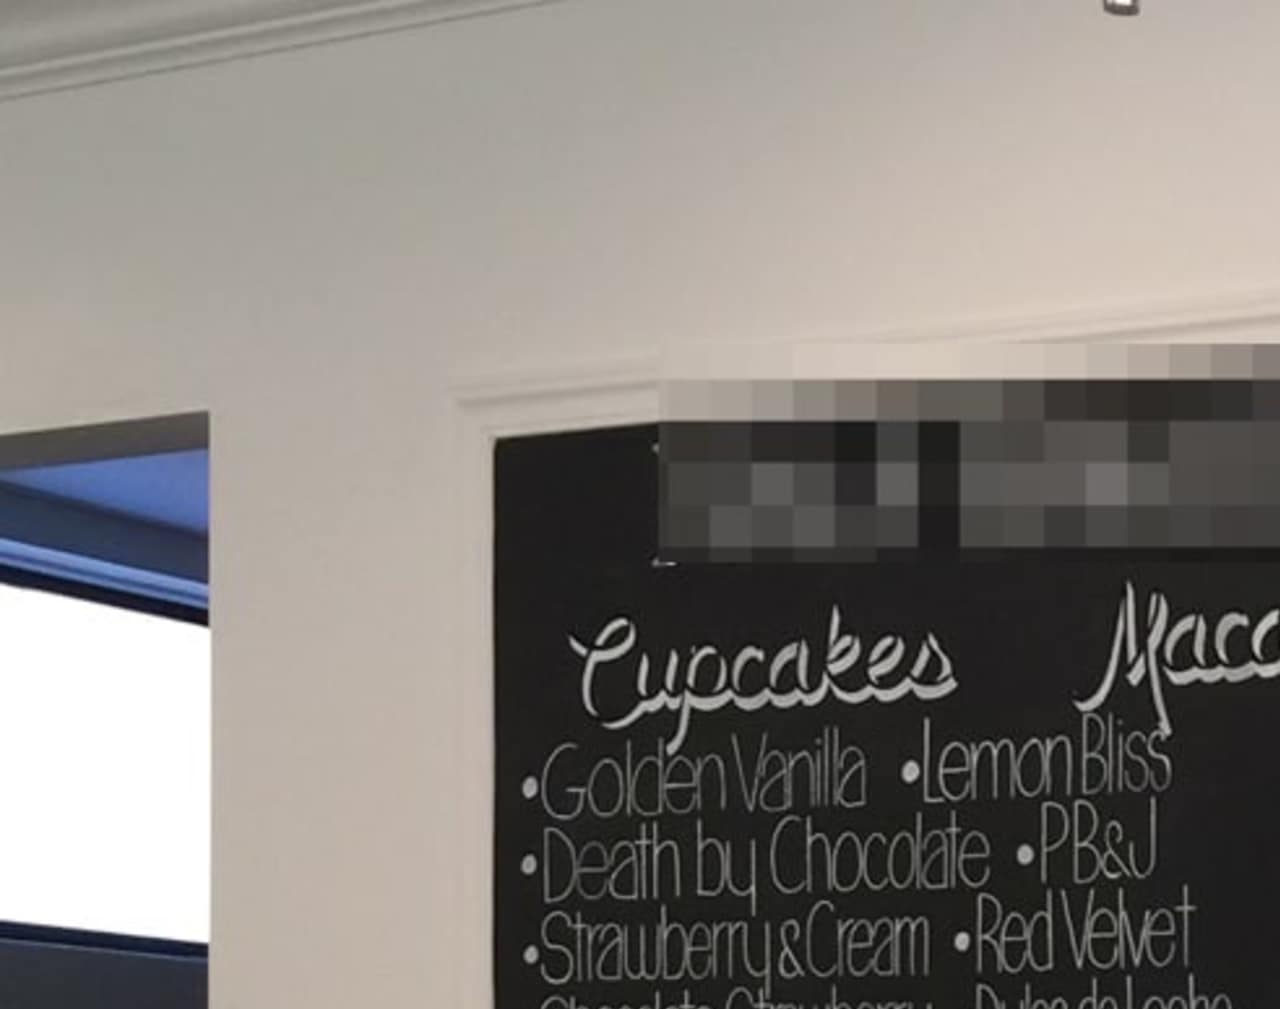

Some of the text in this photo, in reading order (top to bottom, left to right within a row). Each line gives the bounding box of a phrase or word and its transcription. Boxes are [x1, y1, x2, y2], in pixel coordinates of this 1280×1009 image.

[569, 604, 958, 755] Cupcakes
[542, 726, 866, 820] Golden Vanilla
[924, 712, 1172, 802] Lemon Bliss
[543, 810, 991, 916] Death by Chocolate
[1040, 796, 1157, 884] PB&J
[540, 901, 930, 1000] Strawberry & Cream
[976, 885, 1197, 973] Red Velvet
